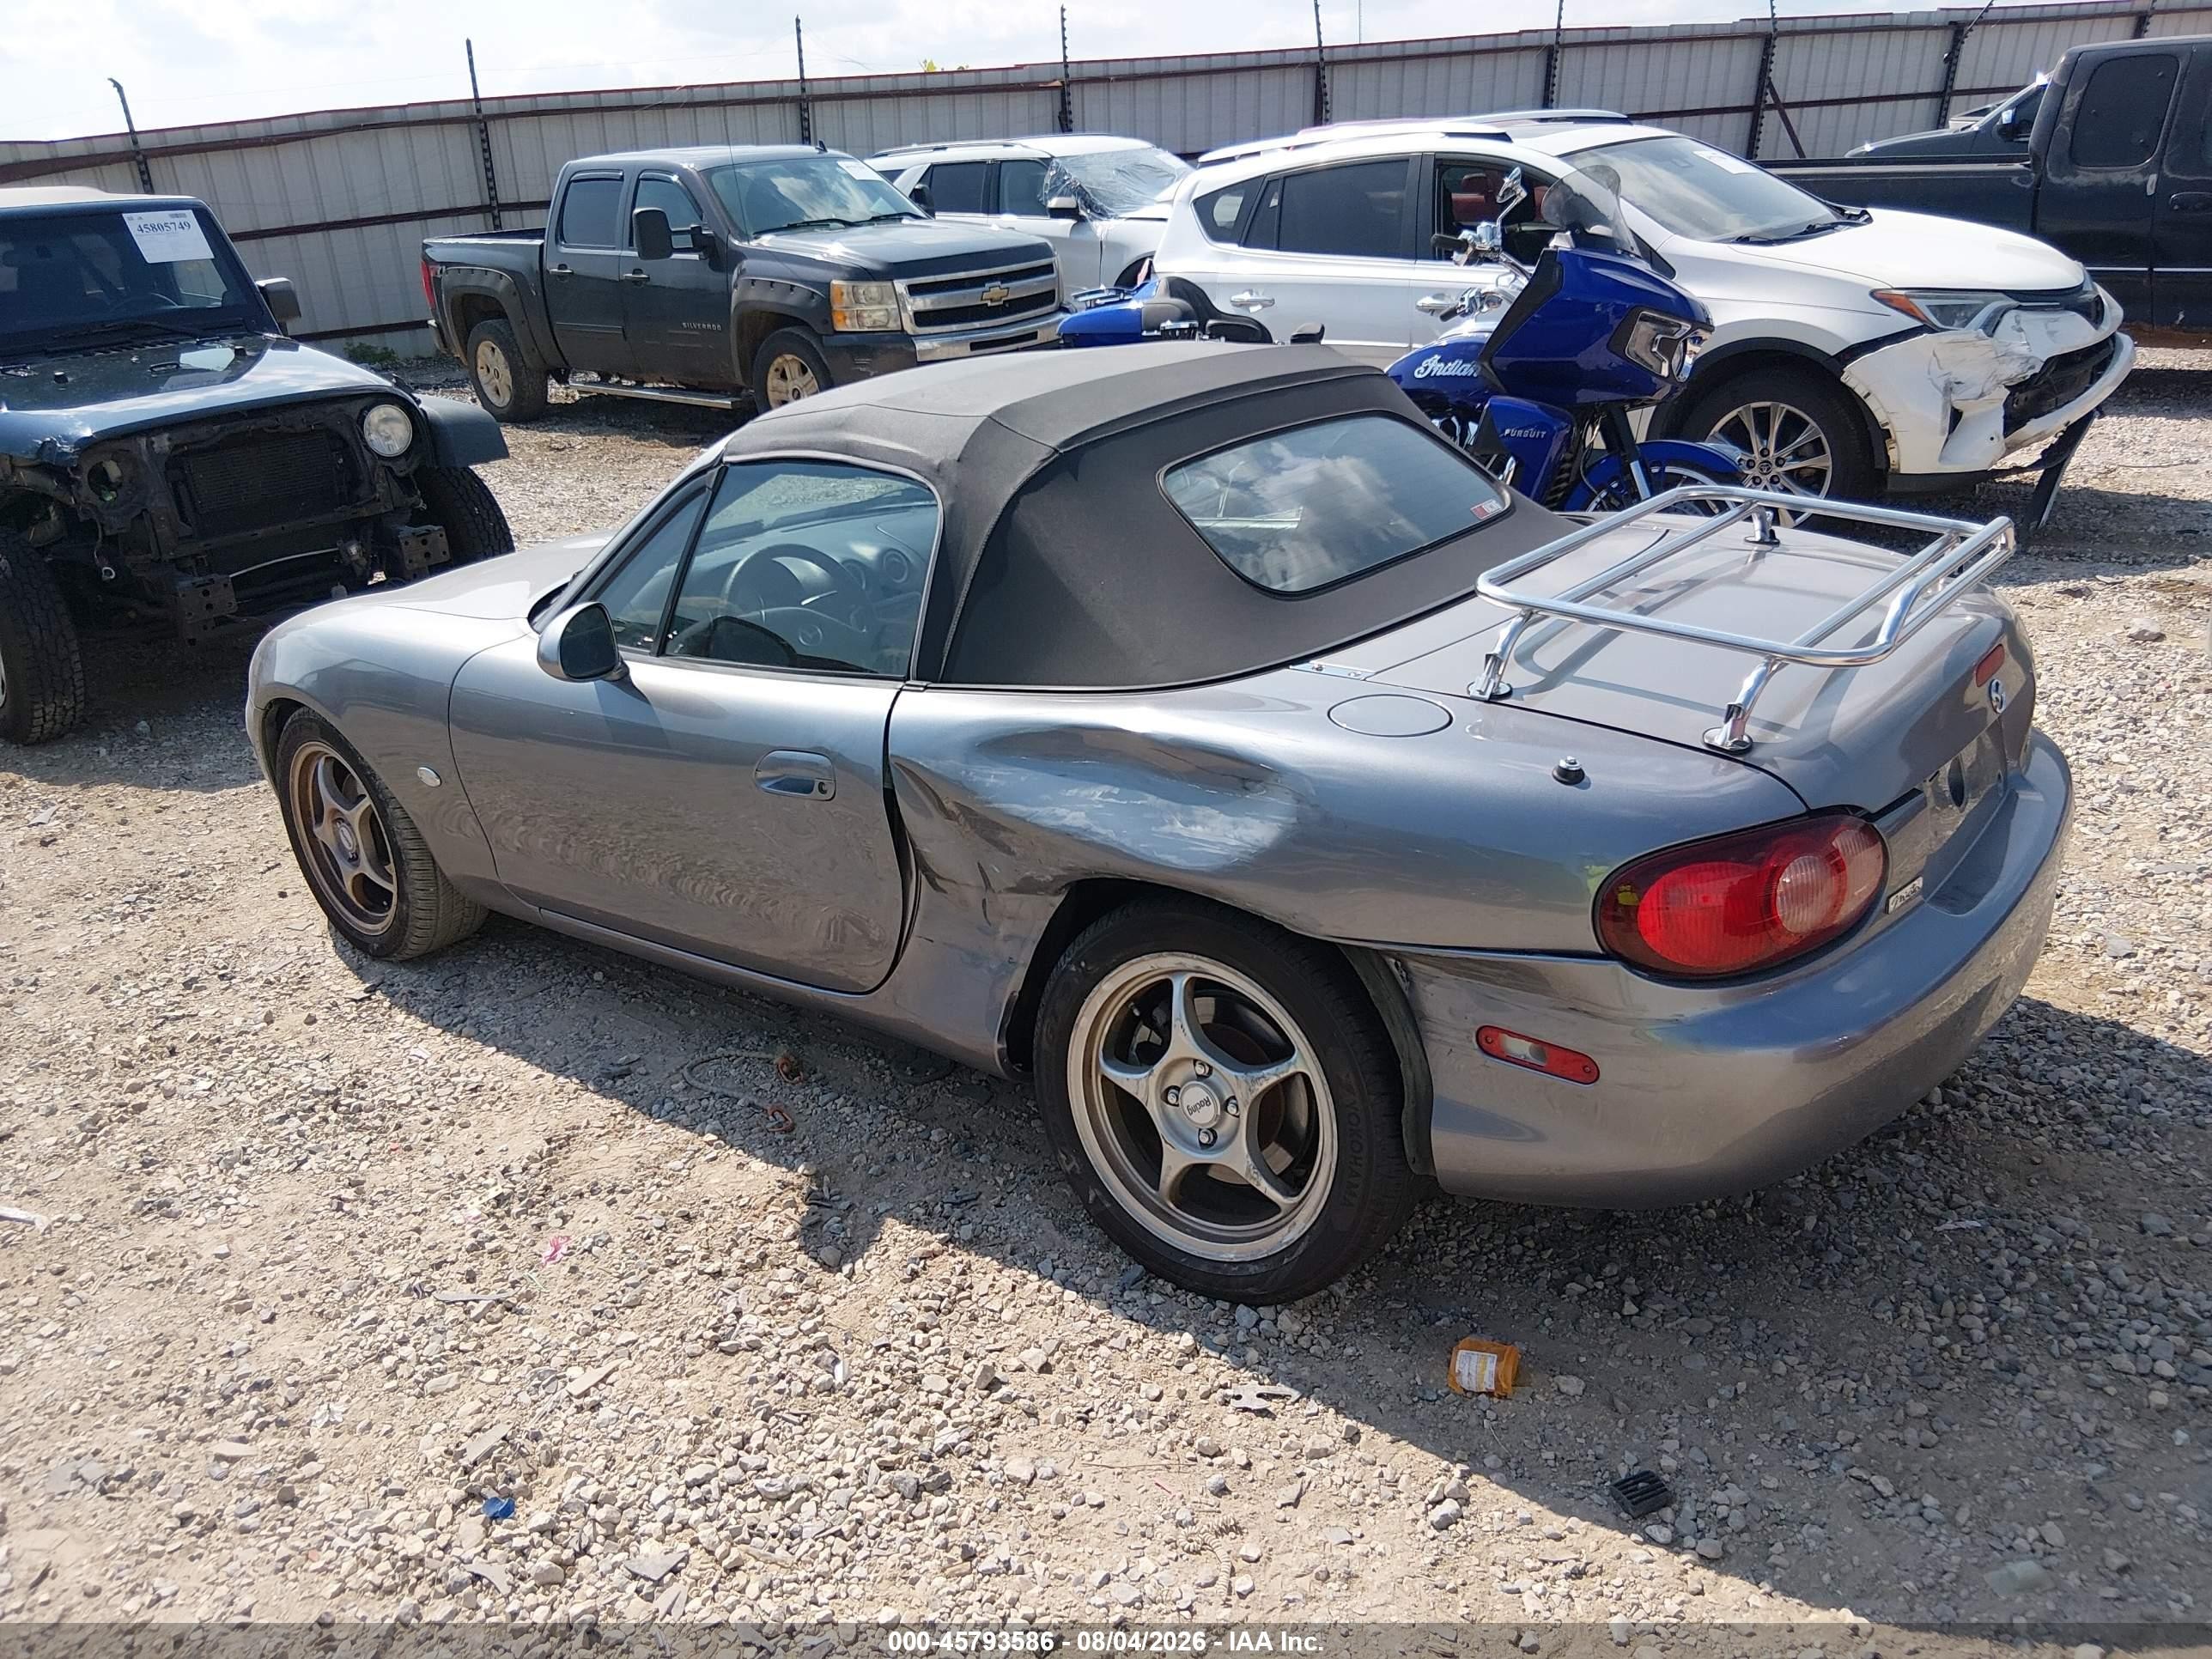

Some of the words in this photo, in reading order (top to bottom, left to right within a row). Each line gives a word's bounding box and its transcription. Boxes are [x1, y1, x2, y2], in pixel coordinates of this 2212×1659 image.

[137, 222, 191, 234] 45805749
[682, 322, 722, 331] SILVERADO
[1414, 355, 1480, 379] Indian
[1504, 428, 1547, 439] PURSUIT
[1186, 1096, 1212, 1116] Racing
[1345, 1099, 1364, 1208] YOKOHAMA
